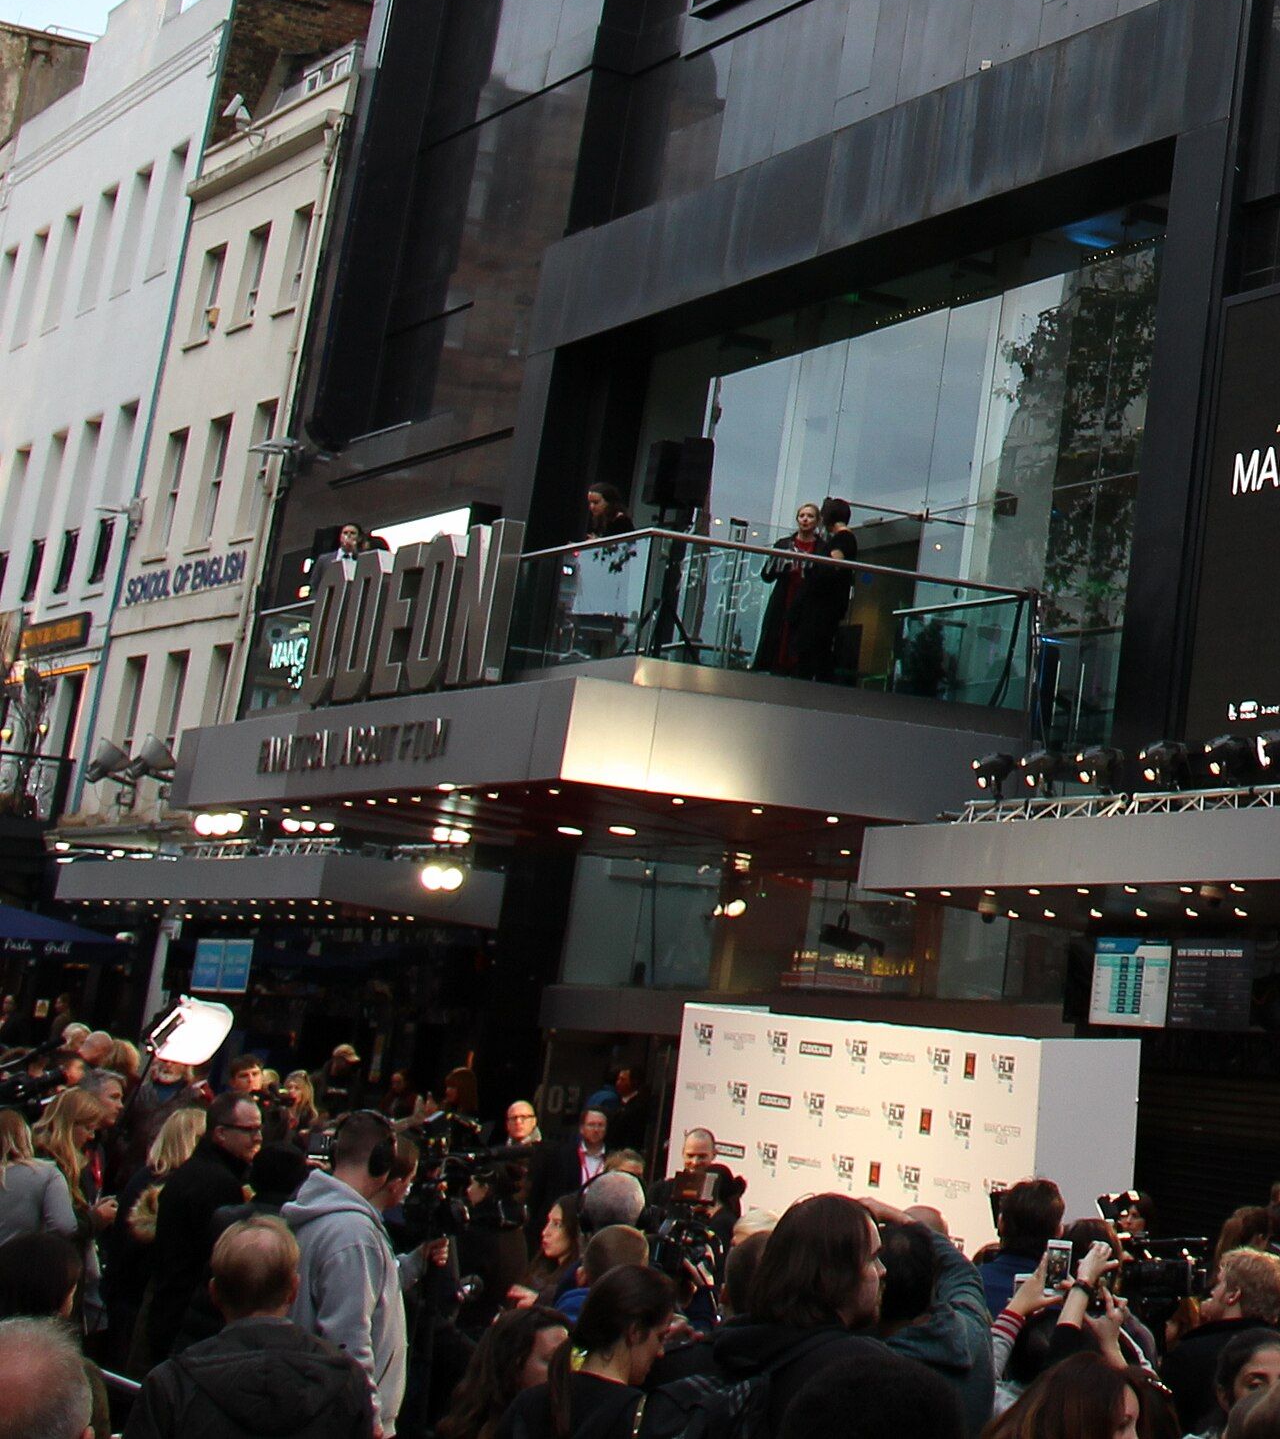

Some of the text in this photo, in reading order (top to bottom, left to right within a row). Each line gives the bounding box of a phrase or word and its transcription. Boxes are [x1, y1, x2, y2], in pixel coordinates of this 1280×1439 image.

[125, 550, 247, 607] SCHOOL OF ENGLISH
[302, 517, 526, 710] ODEON
